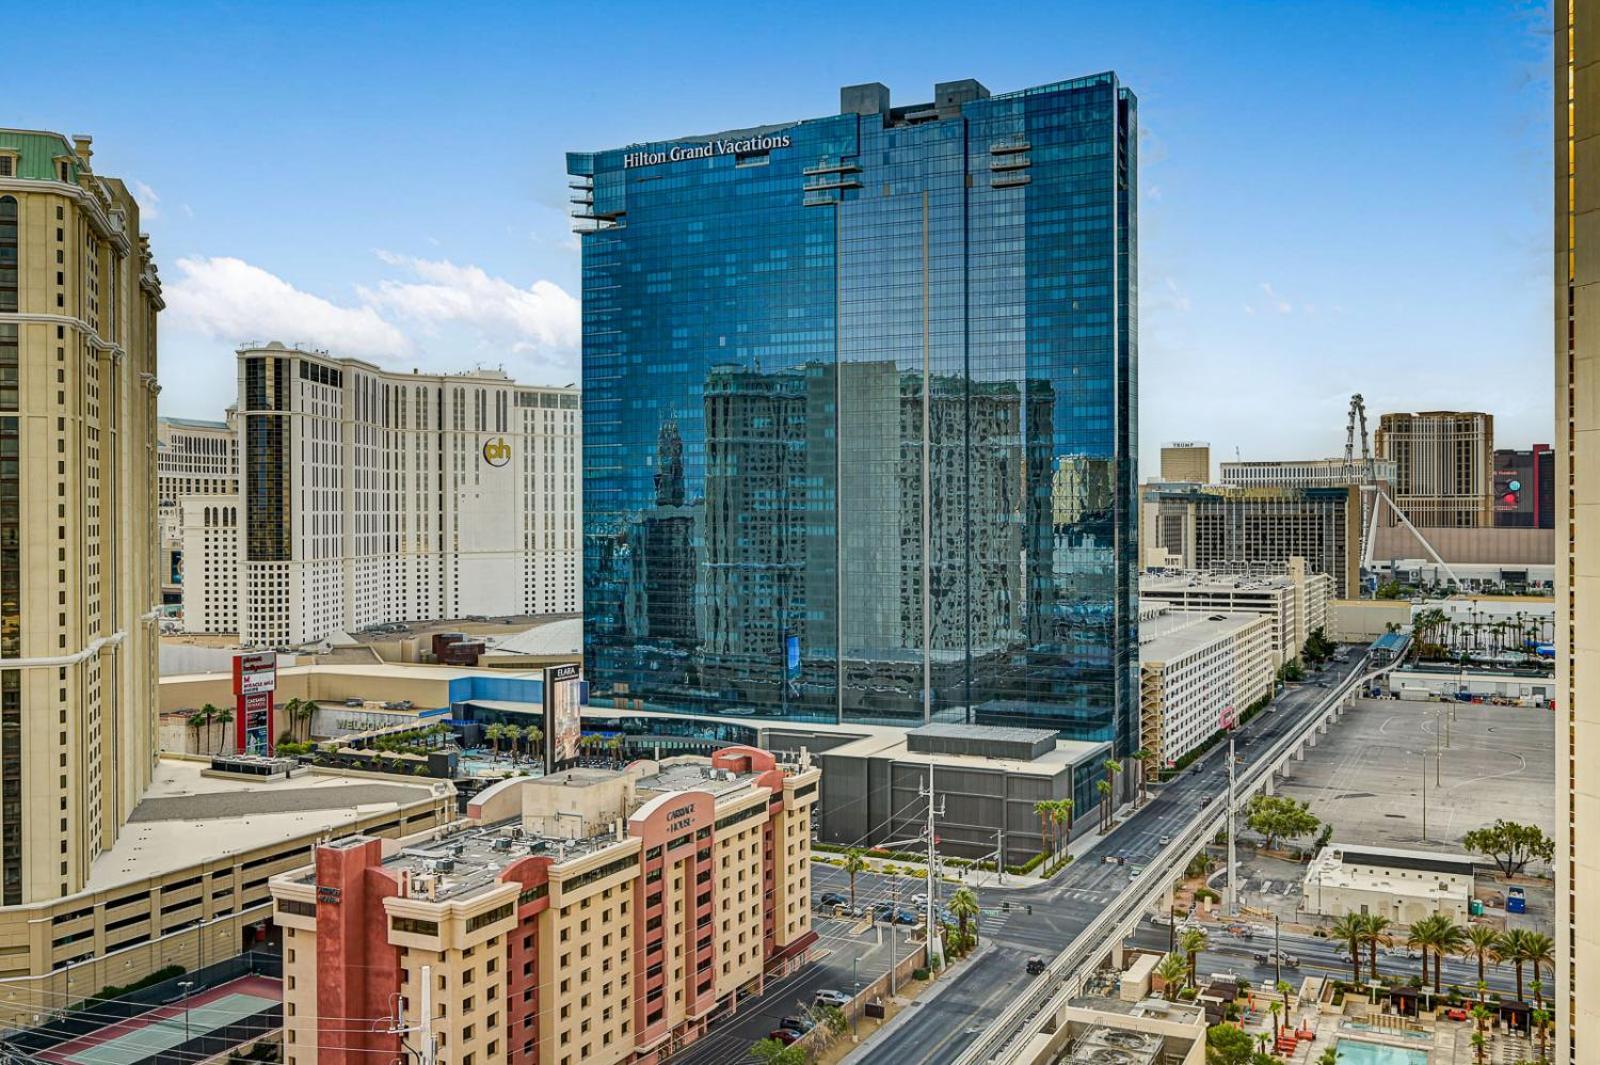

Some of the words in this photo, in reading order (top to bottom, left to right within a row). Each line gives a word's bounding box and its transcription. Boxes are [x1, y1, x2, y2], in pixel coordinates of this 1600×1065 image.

[624, 150, 666, 169] Hilton
[670, 142, 713, 161] Grand
[716, 134, 790, 155] Vacations
[485, 437, 512, 461] ph
